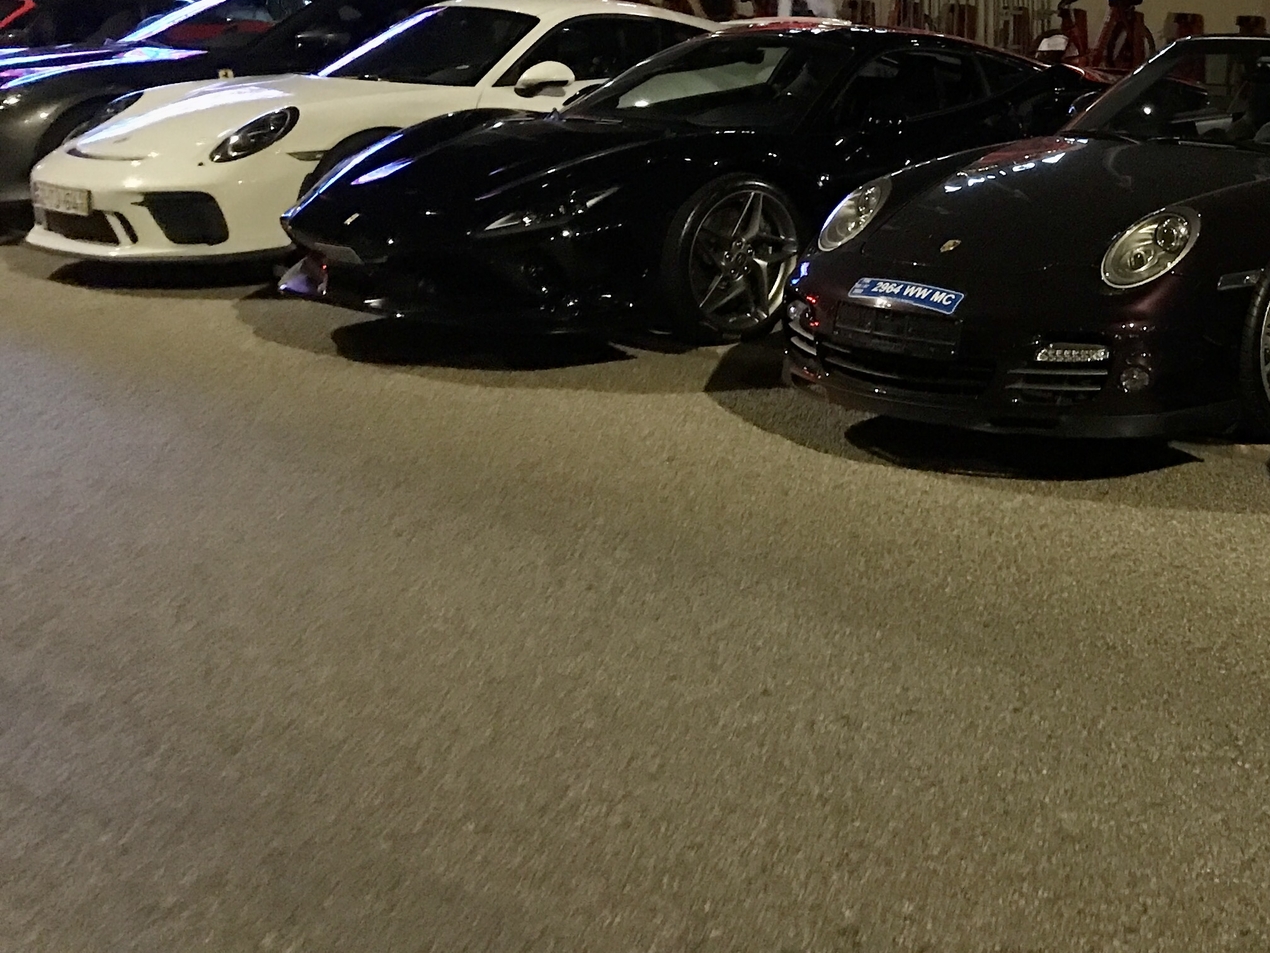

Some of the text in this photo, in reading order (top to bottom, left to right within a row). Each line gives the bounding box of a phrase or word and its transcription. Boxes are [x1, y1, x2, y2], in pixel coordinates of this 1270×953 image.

[871, 281, 956, 305] 2964 WW MC
